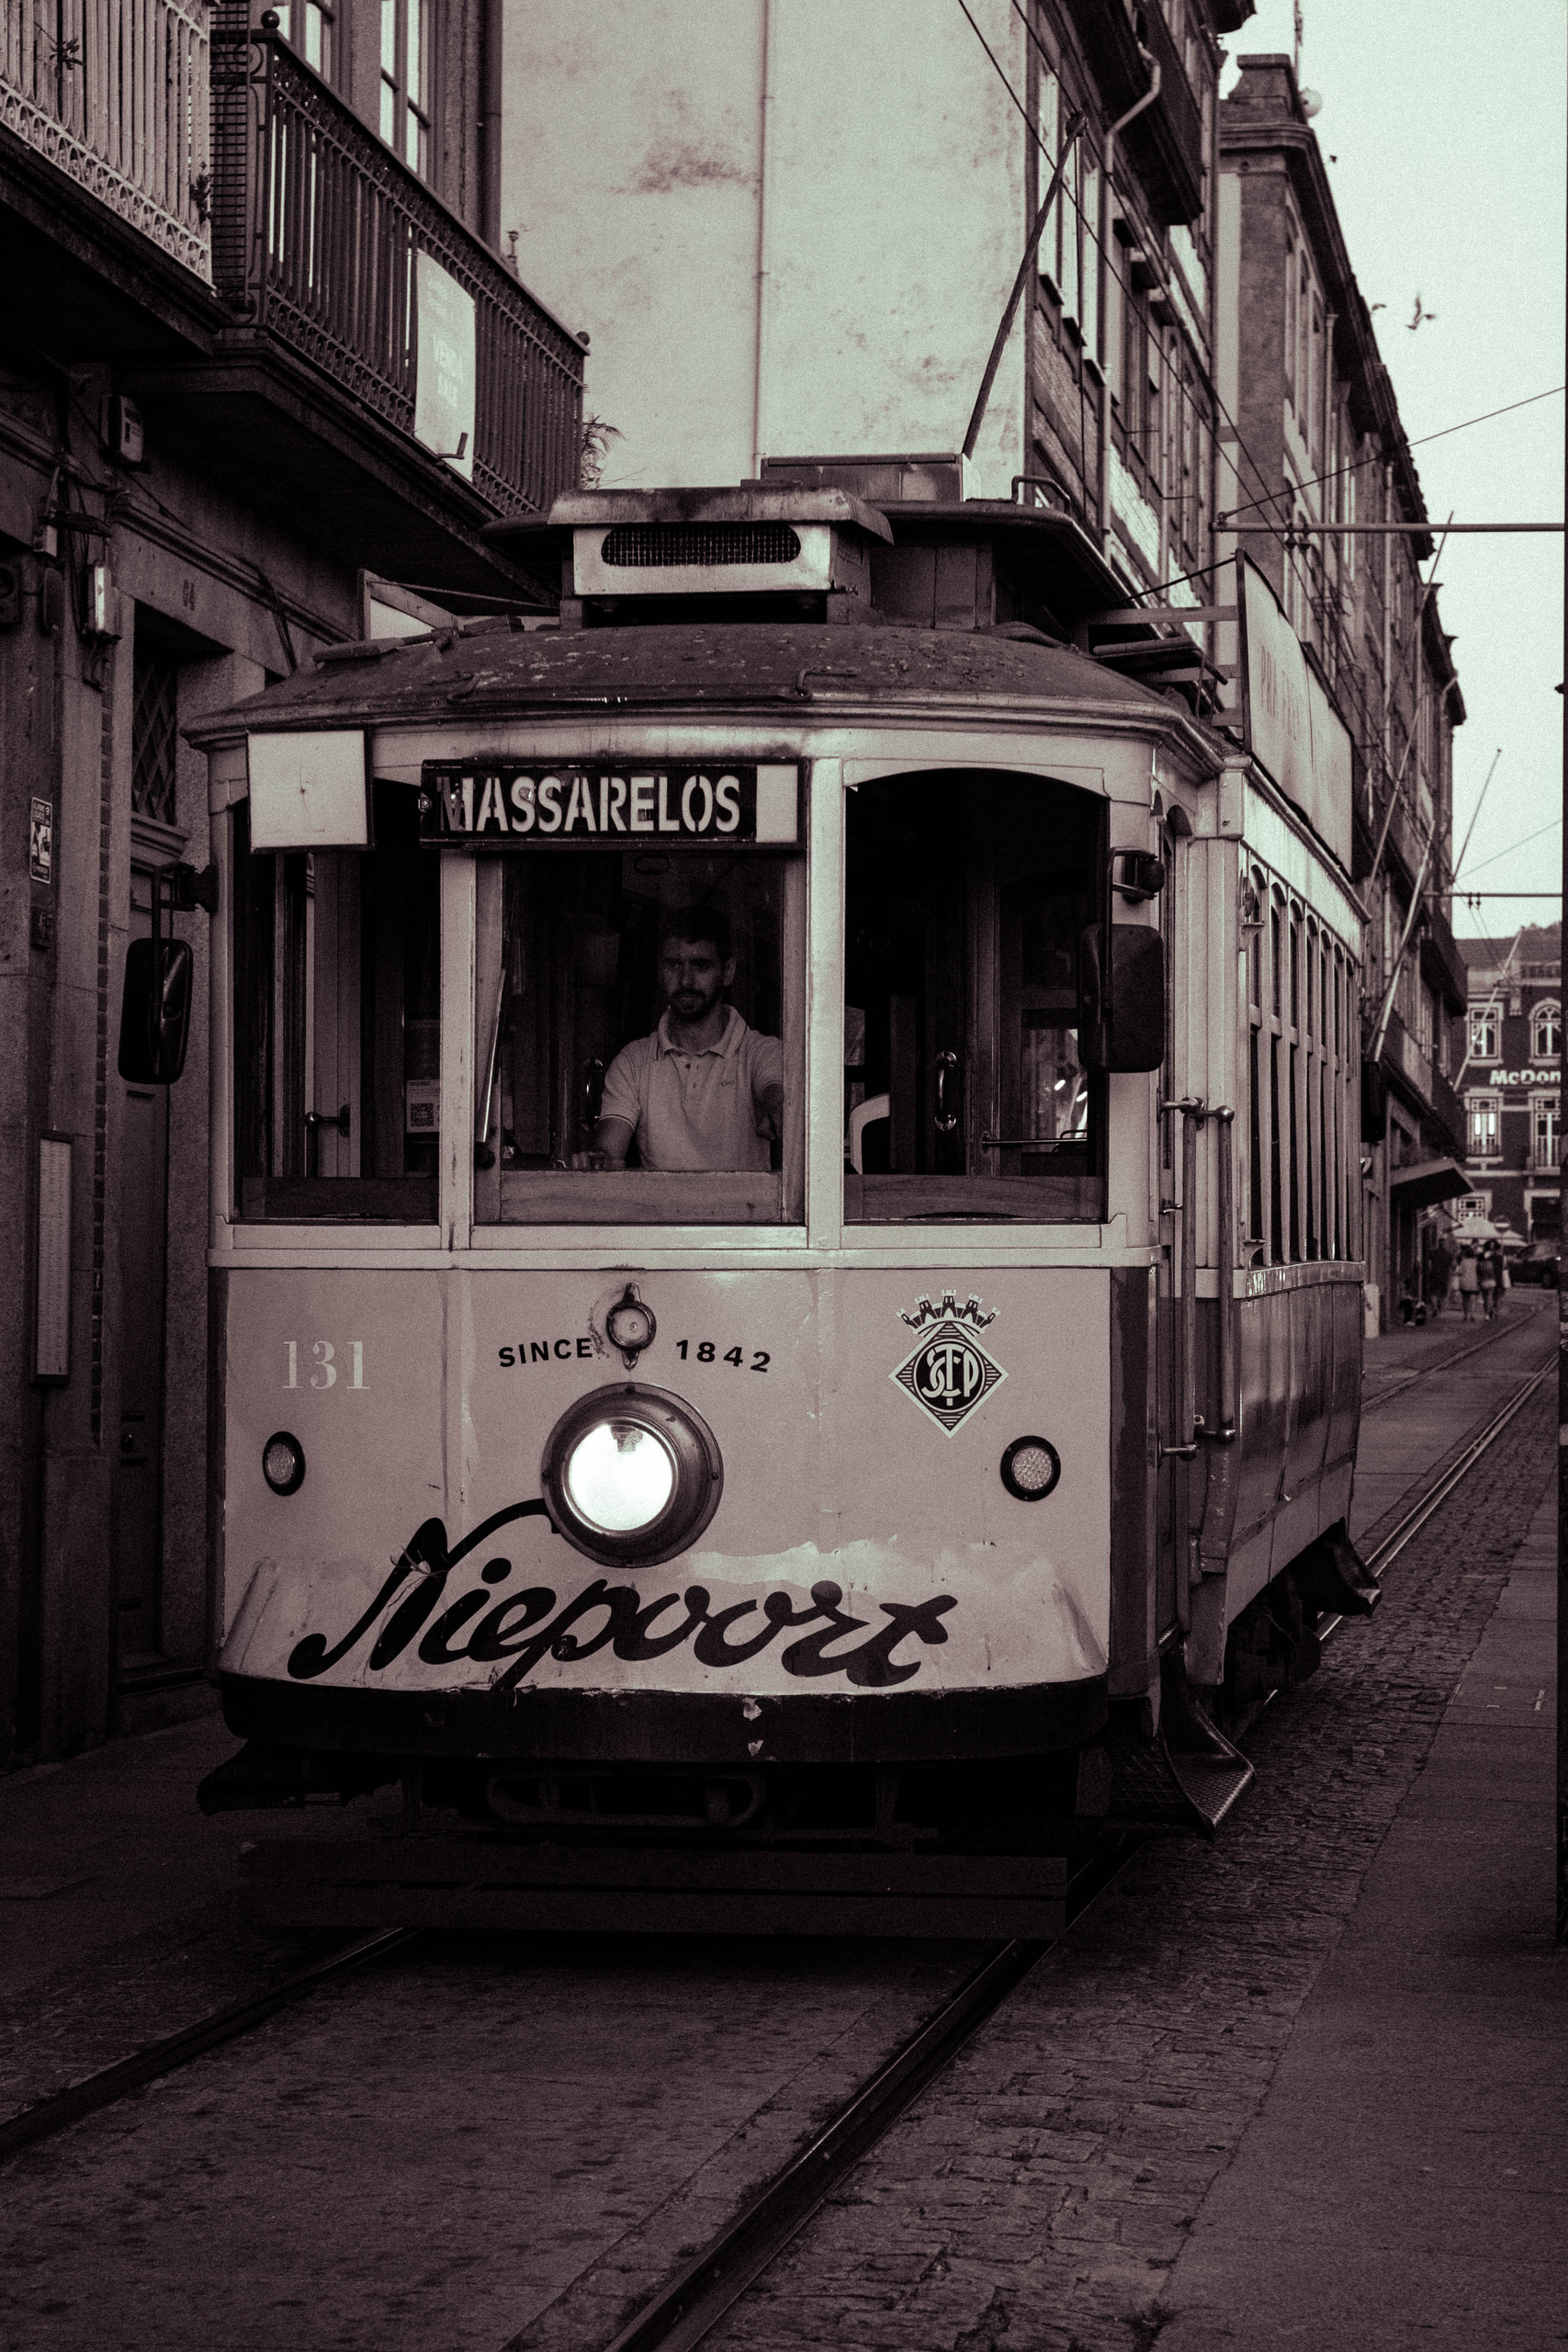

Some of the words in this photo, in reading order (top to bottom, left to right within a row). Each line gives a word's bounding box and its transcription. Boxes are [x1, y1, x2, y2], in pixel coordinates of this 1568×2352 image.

[435, 775, 740, 832] MASSARELOS
[282, 1340, 370, 1390] 131
[498, 1337, 593, 1368] SINCE
[675, 1339, 772, 1373] 1842
